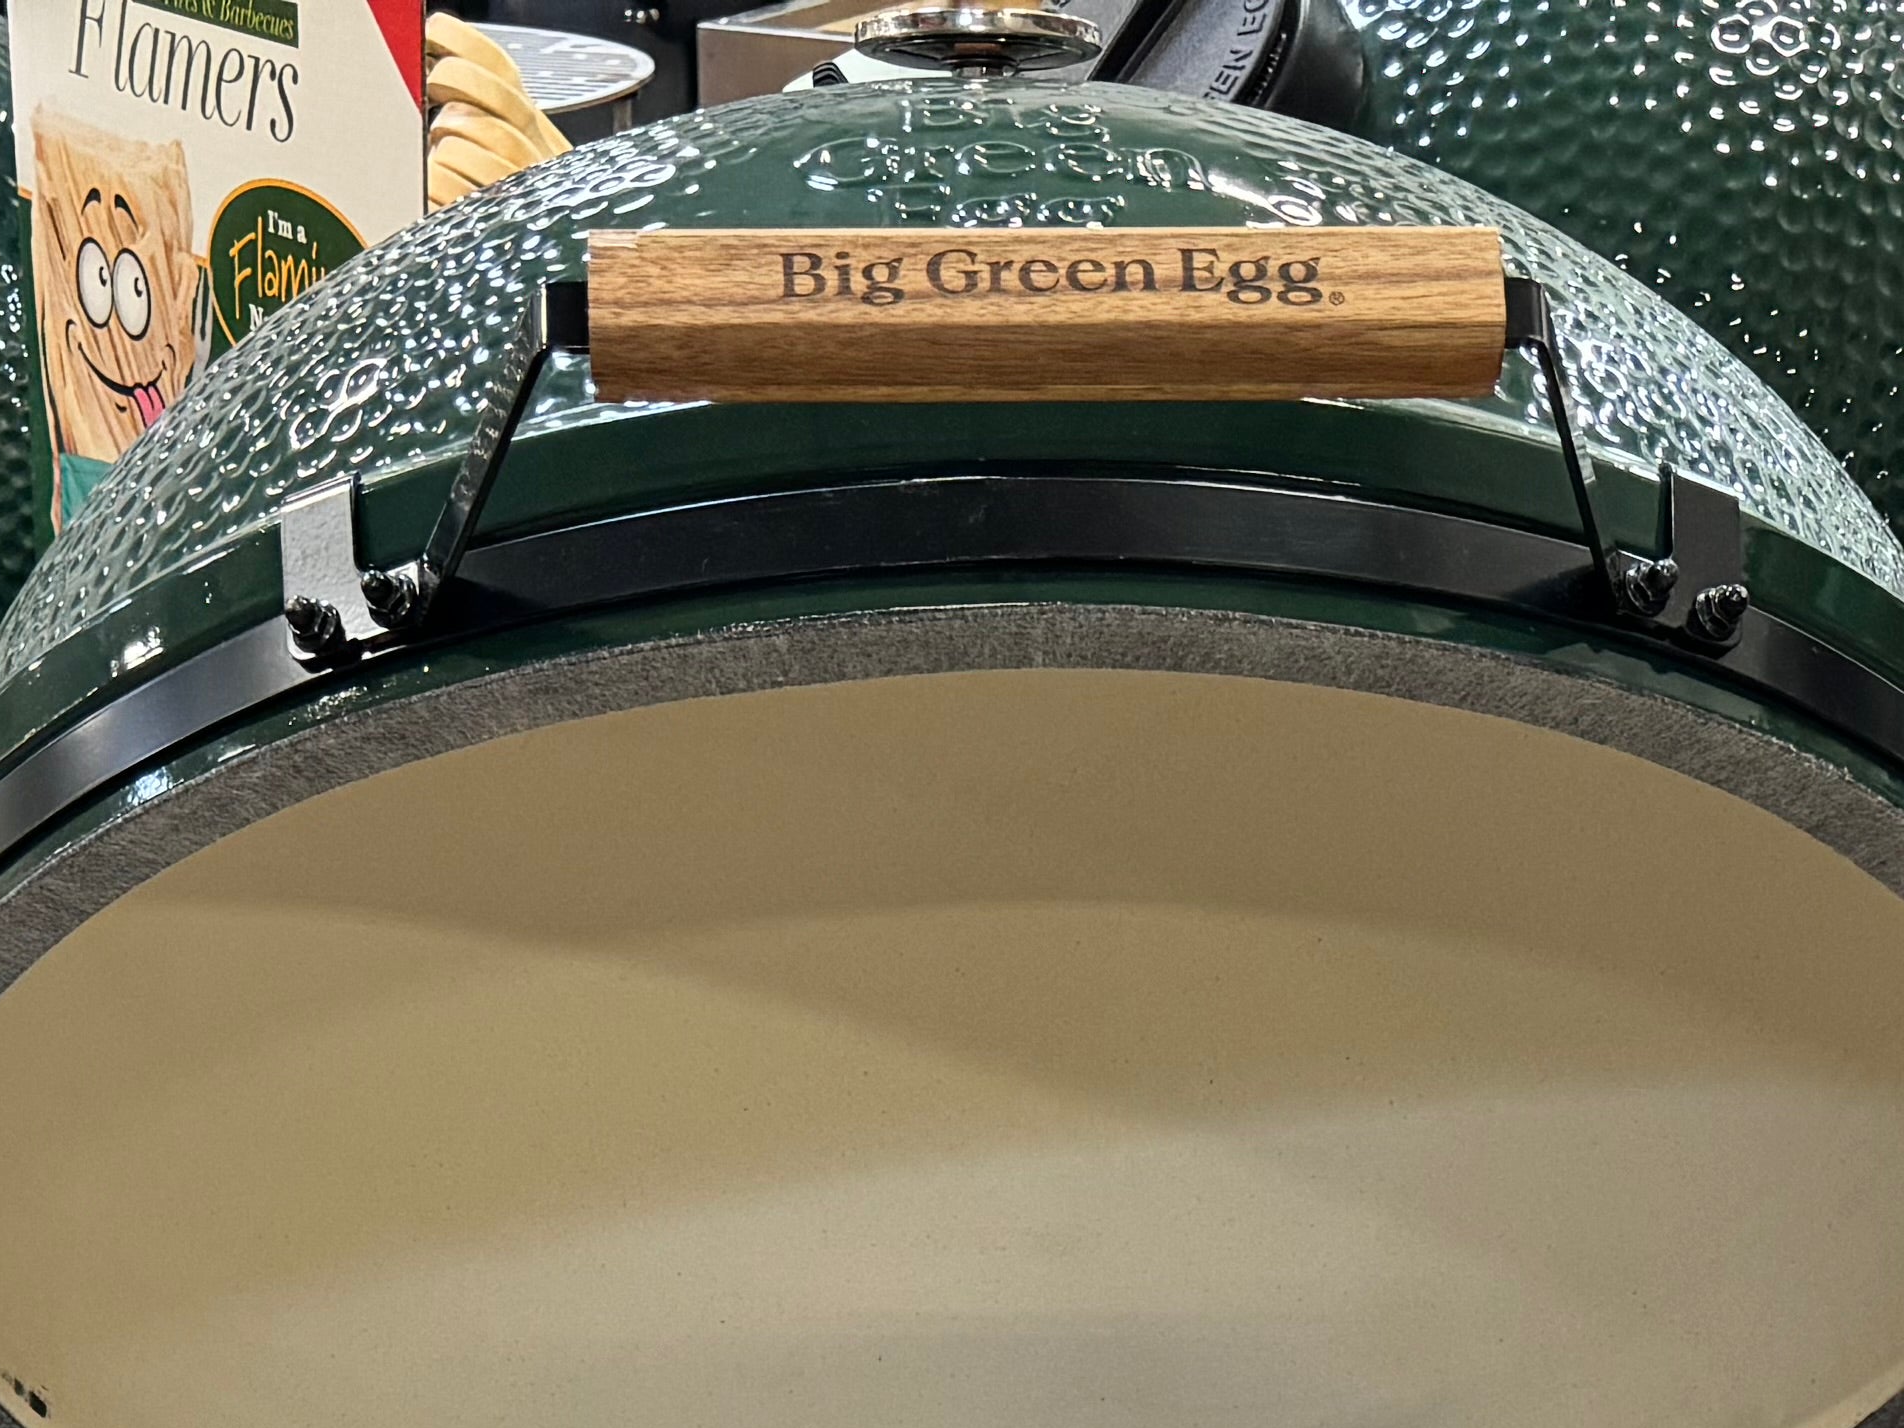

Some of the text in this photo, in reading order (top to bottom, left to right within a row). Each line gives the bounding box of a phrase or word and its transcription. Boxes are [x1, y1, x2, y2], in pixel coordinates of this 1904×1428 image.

[220, 0, 294, 40] Barbecues
[68, 0, 298, 142] Flamers
[267, 210, 307, 244] I'm a
[779, 248, 1324, 306] Big Green Egg
